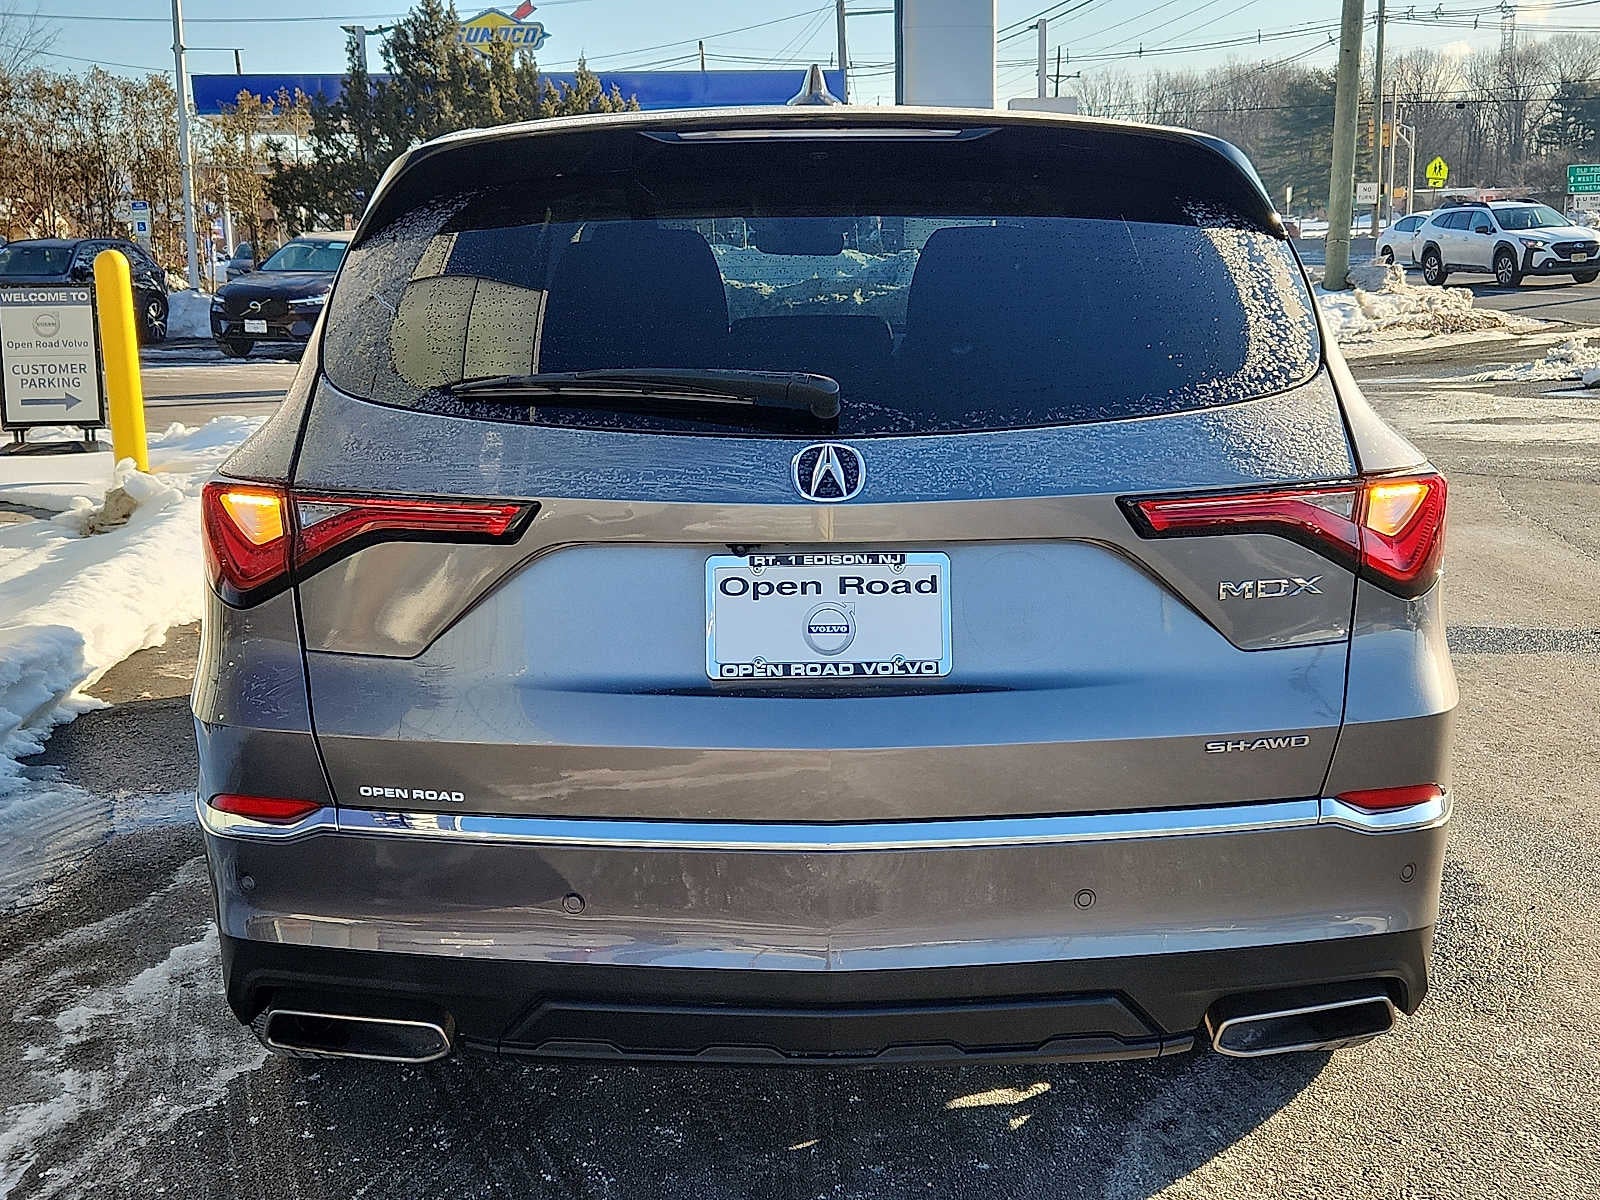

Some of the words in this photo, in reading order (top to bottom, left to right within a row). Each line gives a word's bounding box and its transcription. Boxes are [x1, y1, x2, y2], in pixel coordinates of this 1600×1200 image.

[1, 292, 67, 302] WELCOME
[70, 291, 88, 301] TO
[6, 340, 33, 350] Open
[35, 339, 60, 349] Road
[62, 339, 89, 348] Volvo
[11, 363, 88, 376] CUSTOMER
[20, 376, 81, 389] PARKING
[753, 555, 780, 566] RT.
[788, 555, 797, 565] 1
[803, 555, 873, 566] EDISON,
[878, 554, 900, 565] NJ
[719, 576, 822, 600] Open
[838, 574, 938, 595] Road
[1218, 575, 1324, 601] MDX
[809, 625, 848, 634] VOLVO
[721, 663, 783, 677] OPEN
[790, 662, 855, 676] ROAD
[861, 661, 937, 675] VOLVO
[1205, 735, 1310, 754] SH-AWD
[359, 786, 409, 799] OPEN
[412, 789, 465, 802] ROAD
